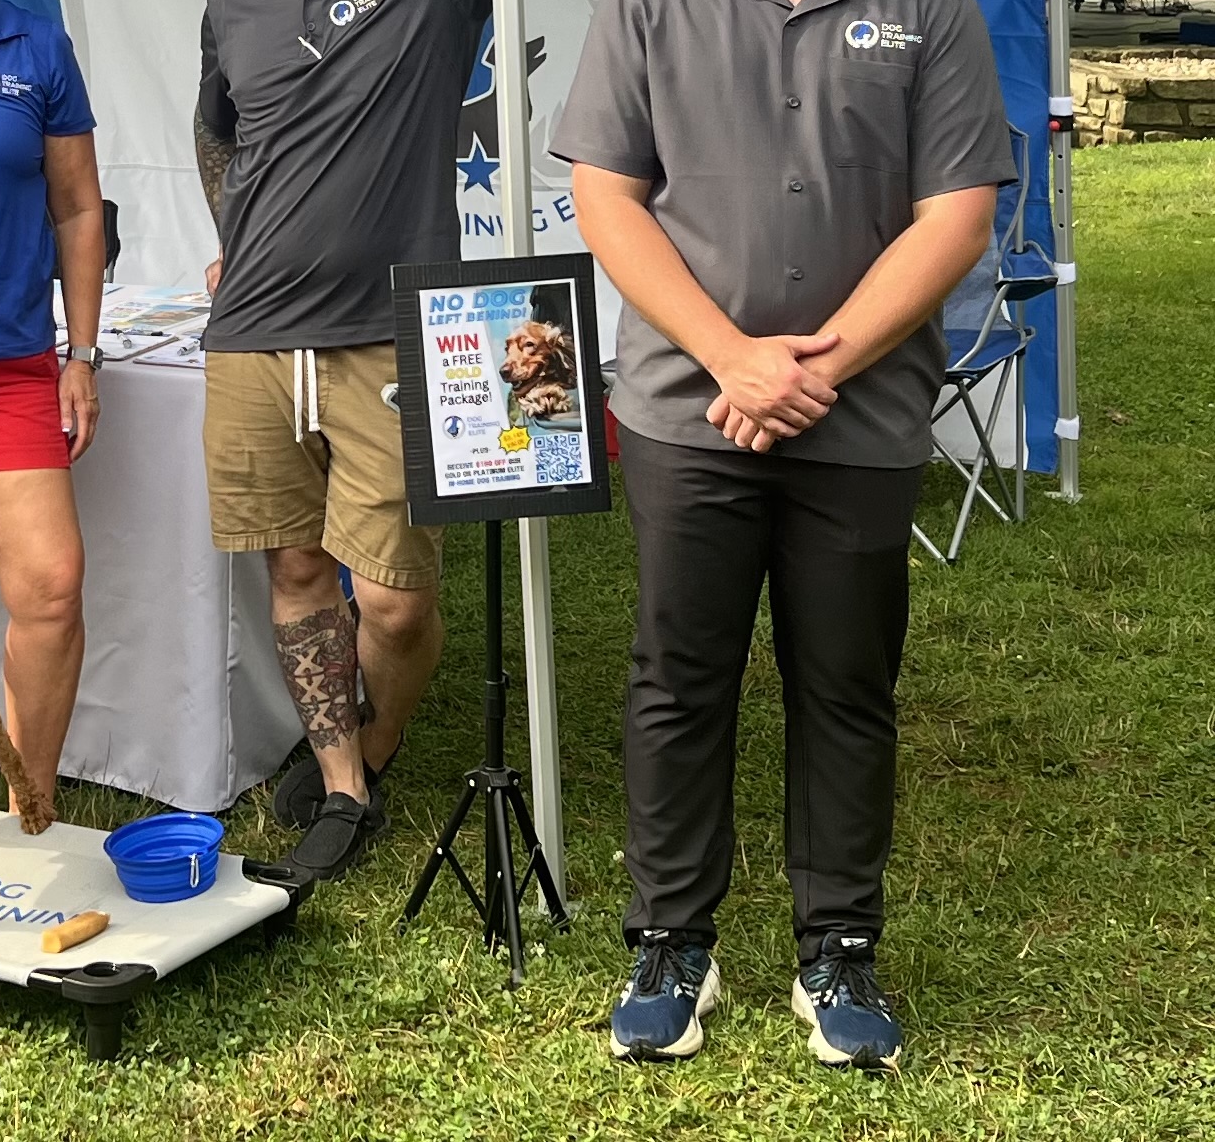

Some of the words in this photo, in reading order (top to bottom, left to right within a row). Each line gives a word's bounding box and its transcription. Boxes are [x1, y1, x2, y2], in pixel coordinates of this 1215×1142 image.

[881, 23, 903, 33] DOG
[429, 294, 464, 313] NO
[472, 288, 525, 309] DOG
[428, 313, 462, 326] LEFT
[466, 307, 527, 323] BEHIND!
[436, 333, 479, 353] WIN
[442, 358, 449, 367] a
[452, 353, 483, 366] FREE
[445, 366, 482, 380] GOLD
[440, 379, 490, 393] Training
[440, 392, 493, 406] Package!
